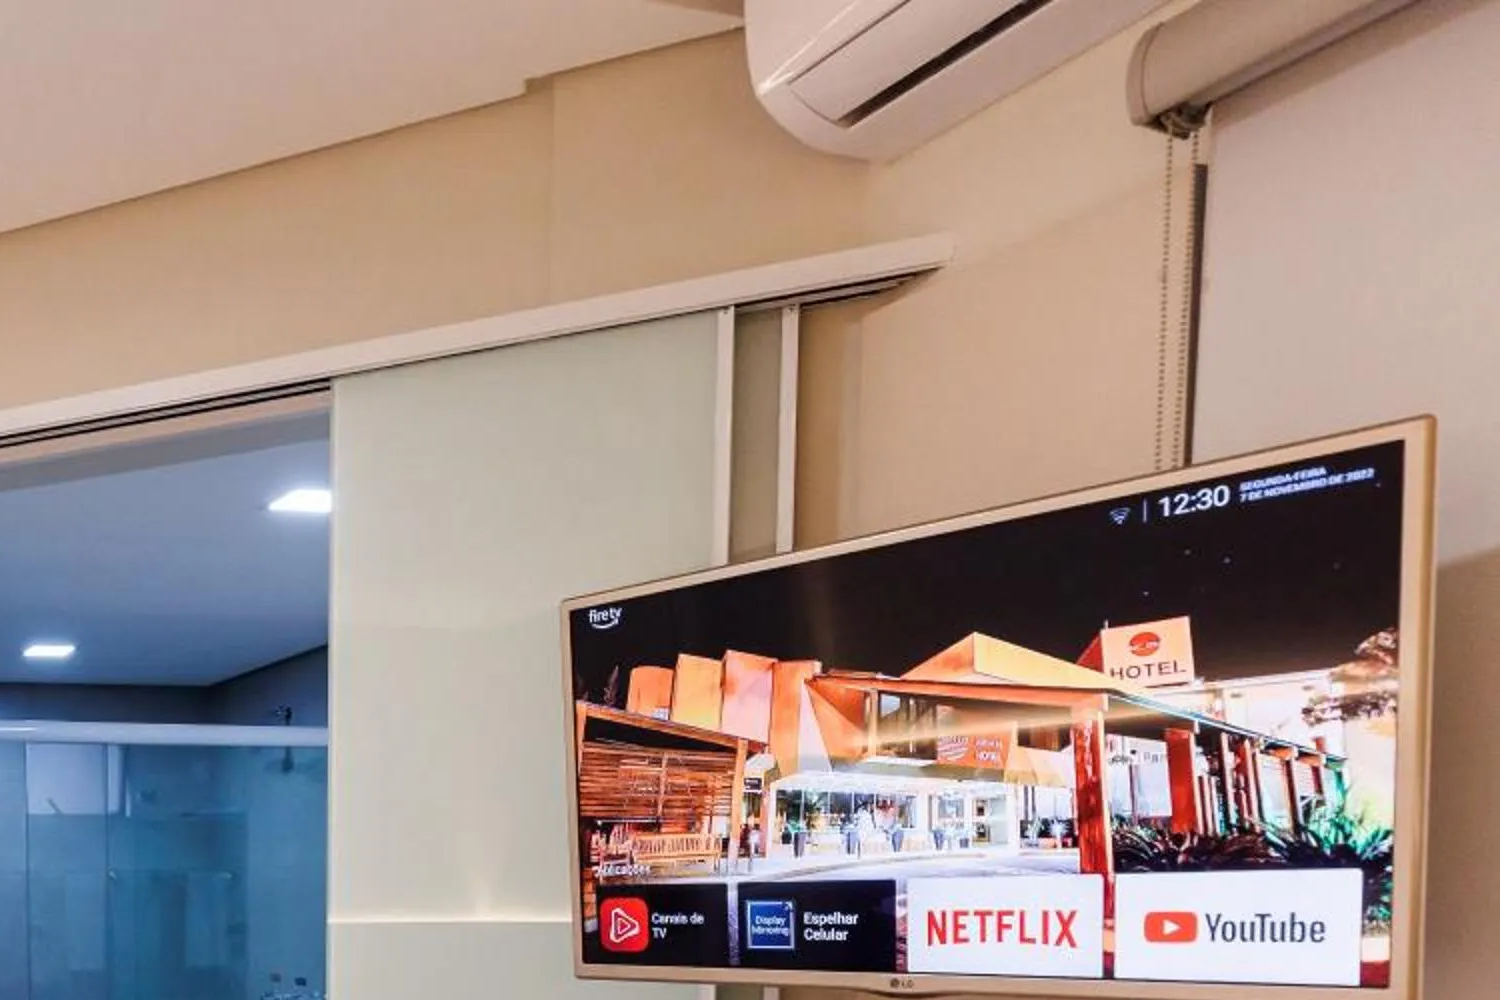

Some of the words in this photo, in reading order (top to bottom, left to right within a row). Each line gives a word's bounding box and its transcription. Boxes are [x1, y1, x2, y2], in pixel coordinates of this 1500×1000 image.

[1158, 485, 1230, 517] 12:30
[1110, 660, 1187, 680] HOTEL
[803, 911, 859, 927] Espelhar
[927, 910, 1077, 948] NETFLIX
[1205, 912, 1326, 944] YouTube
[651, 927, 667, 939] TV
[803, 927, 849, 941] Celular
